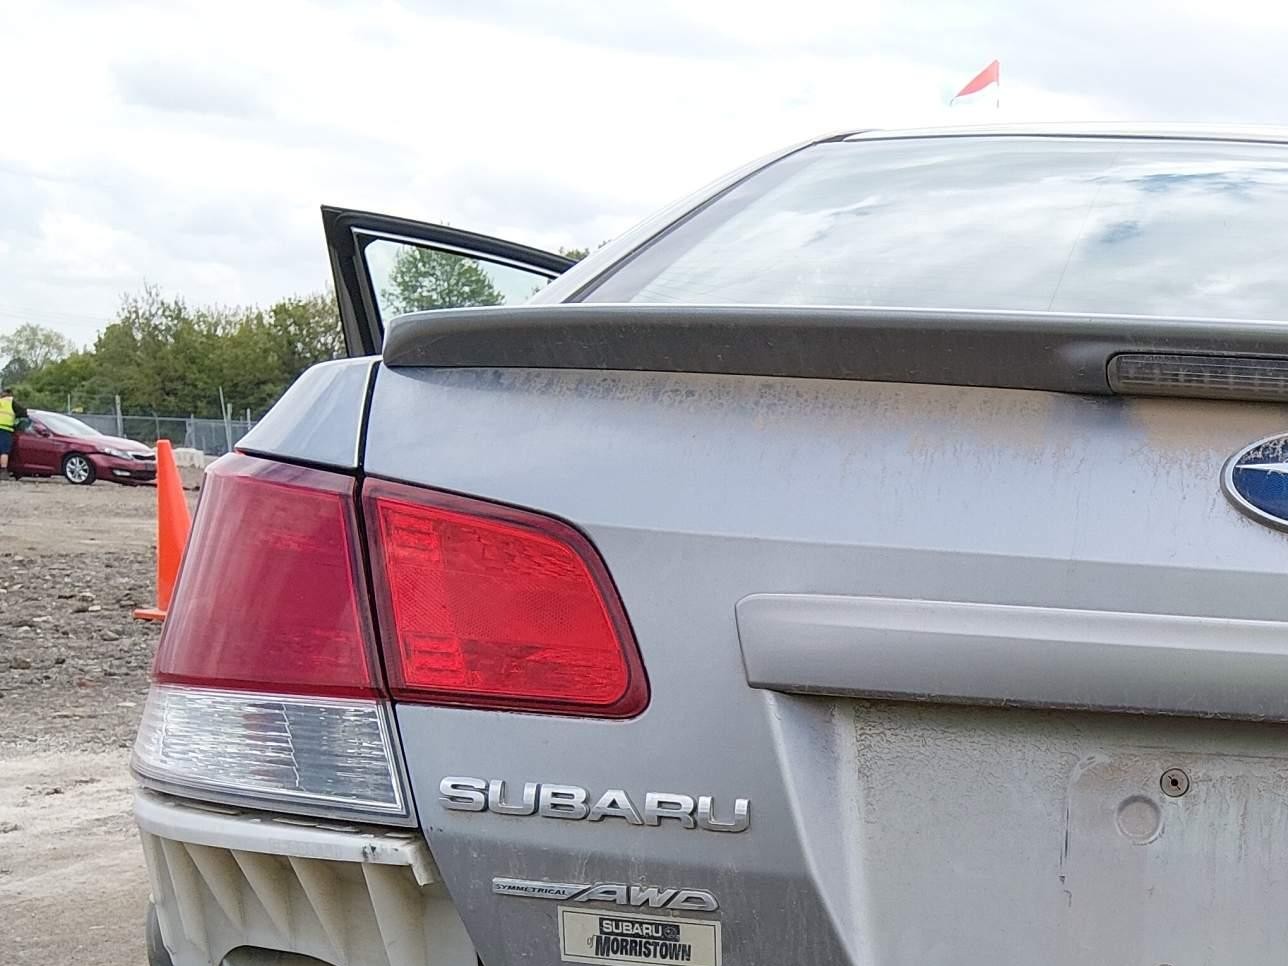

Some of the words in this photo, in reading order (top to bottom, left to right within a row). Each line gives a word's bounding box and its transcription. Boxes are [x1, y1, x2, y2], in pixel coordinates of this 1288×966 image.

[439, 776, 750, 833] SUBARU
[495, 884, 568, 896] SYMMETRICAL
[573, 882, 720, 912] AWD
[602, 920, 662, 937] SUBARU
[594, 935, 692, 962] MORRISTOWN
